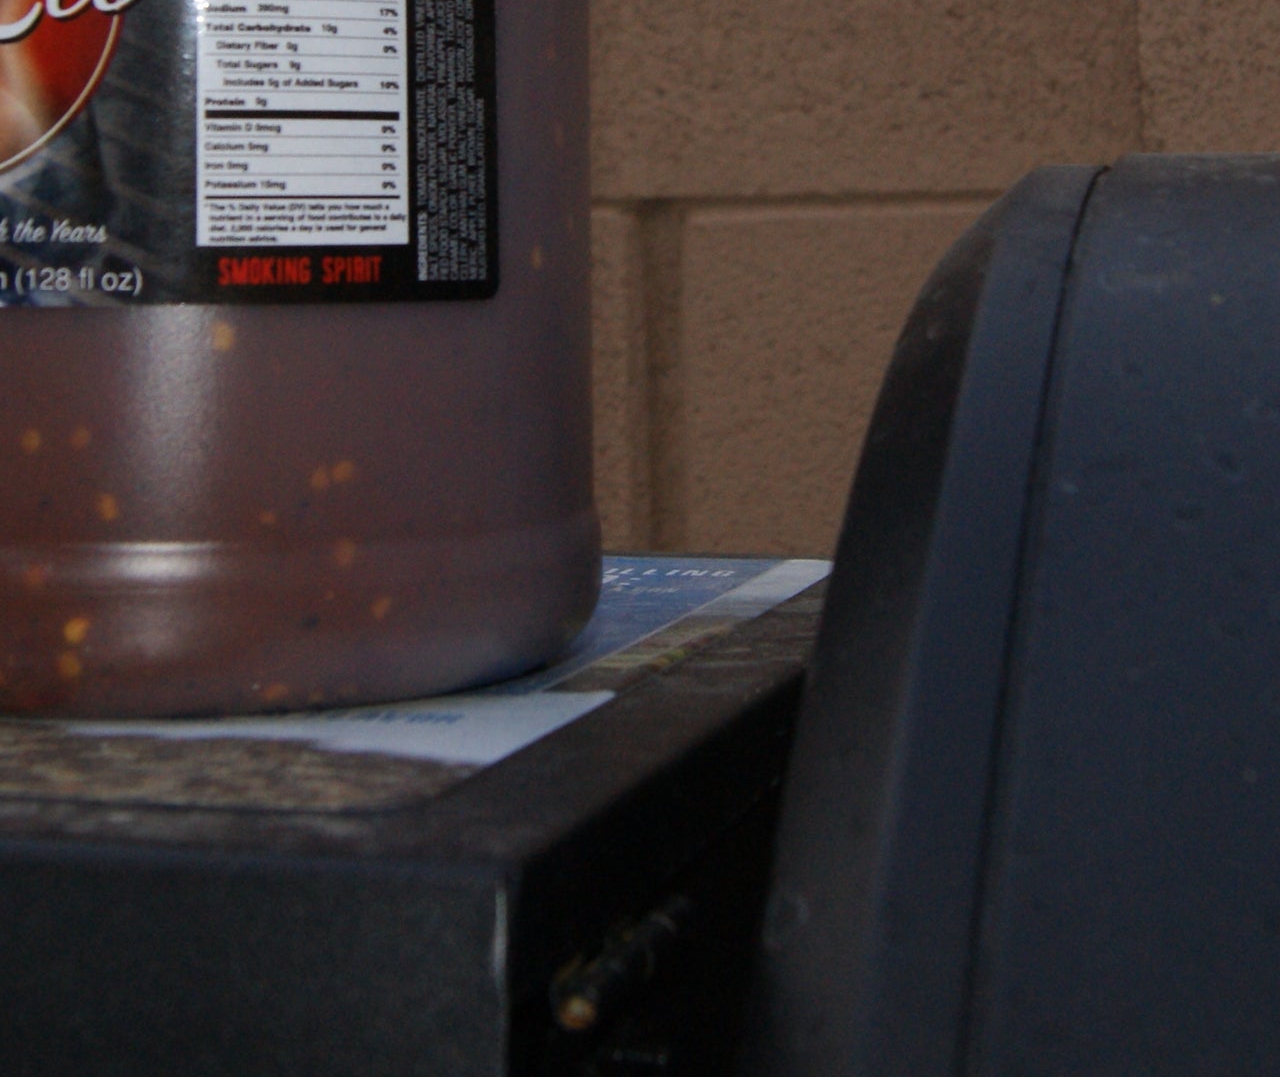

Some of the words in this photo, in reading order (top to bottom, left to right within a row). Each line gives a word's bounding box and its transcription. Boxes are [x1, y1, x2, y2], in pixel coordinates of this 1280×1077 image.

[13, 218, 47, 243] the
[50, 219, 108, 244] Years
[14, 266, 70, 296] (128
[79, 266, 94, 291] fl
[101, 266, 144, 297] oz)
[217, 255, 312, 286] SMOKING
[321, 254, 383, 285] SPIRIT
